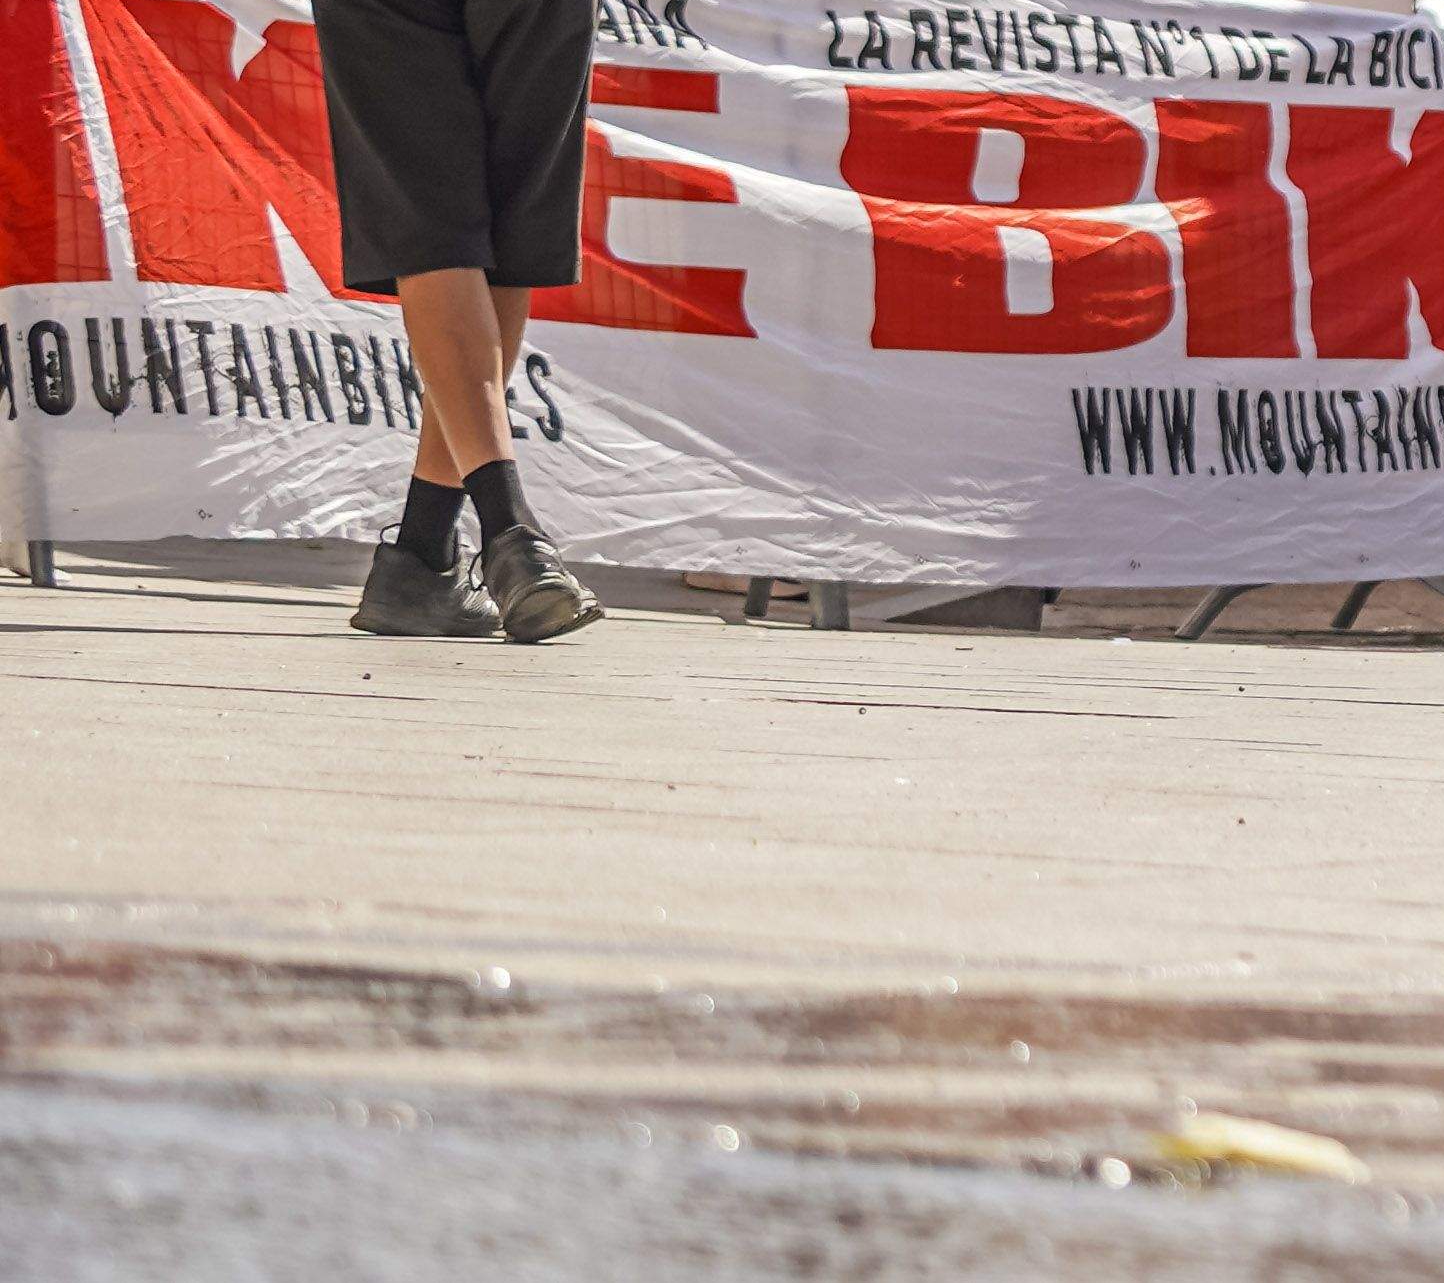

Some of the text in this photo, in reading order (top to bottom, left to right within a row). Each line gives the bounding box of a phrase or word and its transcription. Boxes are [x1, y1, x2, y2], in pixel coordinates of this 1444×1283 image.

[827, 9, 893, 70] LA
[910, 9, 1129, 76] REVISTA
[1221, 26, 1292, 83] DE
[1292, 33, 1357, 86] LA
[1369, 28, 1444, 91] BICI
